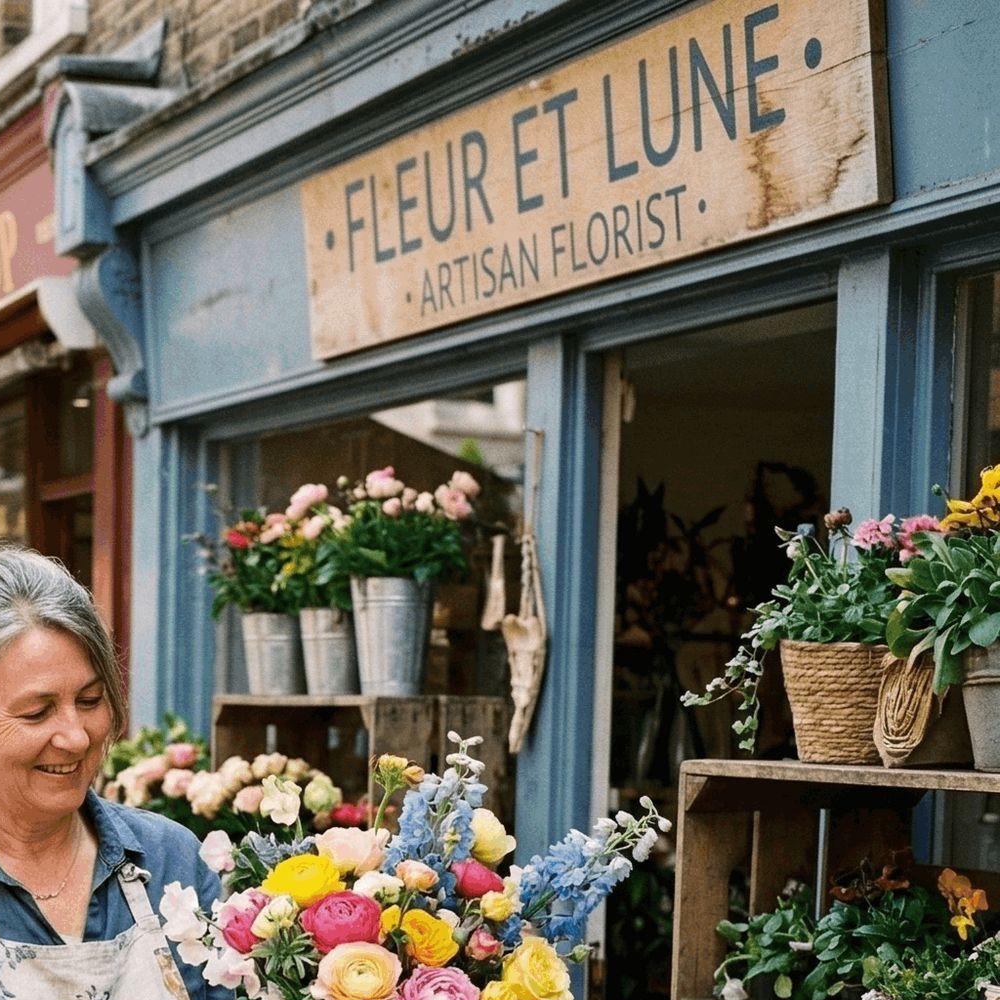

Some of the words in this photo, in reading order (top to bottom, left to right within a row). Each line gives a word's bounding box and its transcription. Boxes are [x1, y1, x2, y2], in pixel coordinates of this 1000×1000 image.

[345, 130, 494, 273] FLEUR
[512, 88, 578, 214] ET
[603, 3, 786, 183] LUNE
[420, 233, 540, 317] ARTISAN
[551, 184, 687, 278] FLORIST
